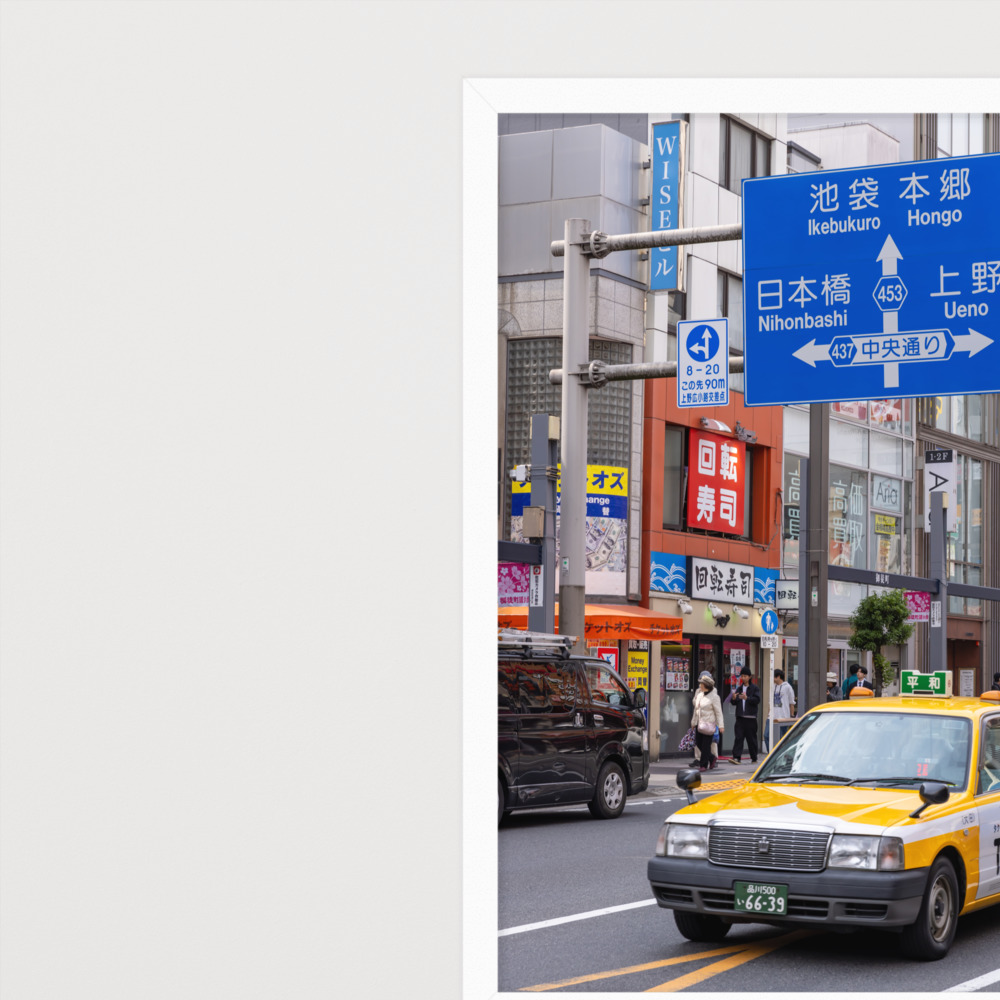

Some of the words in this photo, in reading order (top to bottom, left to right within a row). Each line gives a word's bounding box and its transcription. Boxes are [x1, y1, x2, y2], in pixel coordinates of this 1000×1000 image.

[809, 177, 879, 213] 池袋
[899, 168, 971, 205] 本郷
[655, 136, 677, 277] WISEル
[808, 216, 881, 235] Ikebukuro
[908, 209, 962, 227] Hongo
[758, 273, 851, 310] 日本橋
[877, 284, 903, 303] 453
[758, 310, 848, 332] Nihonbashi
[944, 301, 989, 319] Ueno
[831, 343, 854, 360] 437
[861, 335, 940, 360] 中央通り
[697, 438, 738, 482] 回転
[696, 485, 737, 527] 寿司
[695, 565, 752, 598] 回転寿司
[777, 590, 799, 601] 回転
[585, 621, 632, 634] ケットオズ
[628, 665, 648, 674] Exchange
[631, 656, 645, 665] Money
[907, 676, 940, 690] 平和
